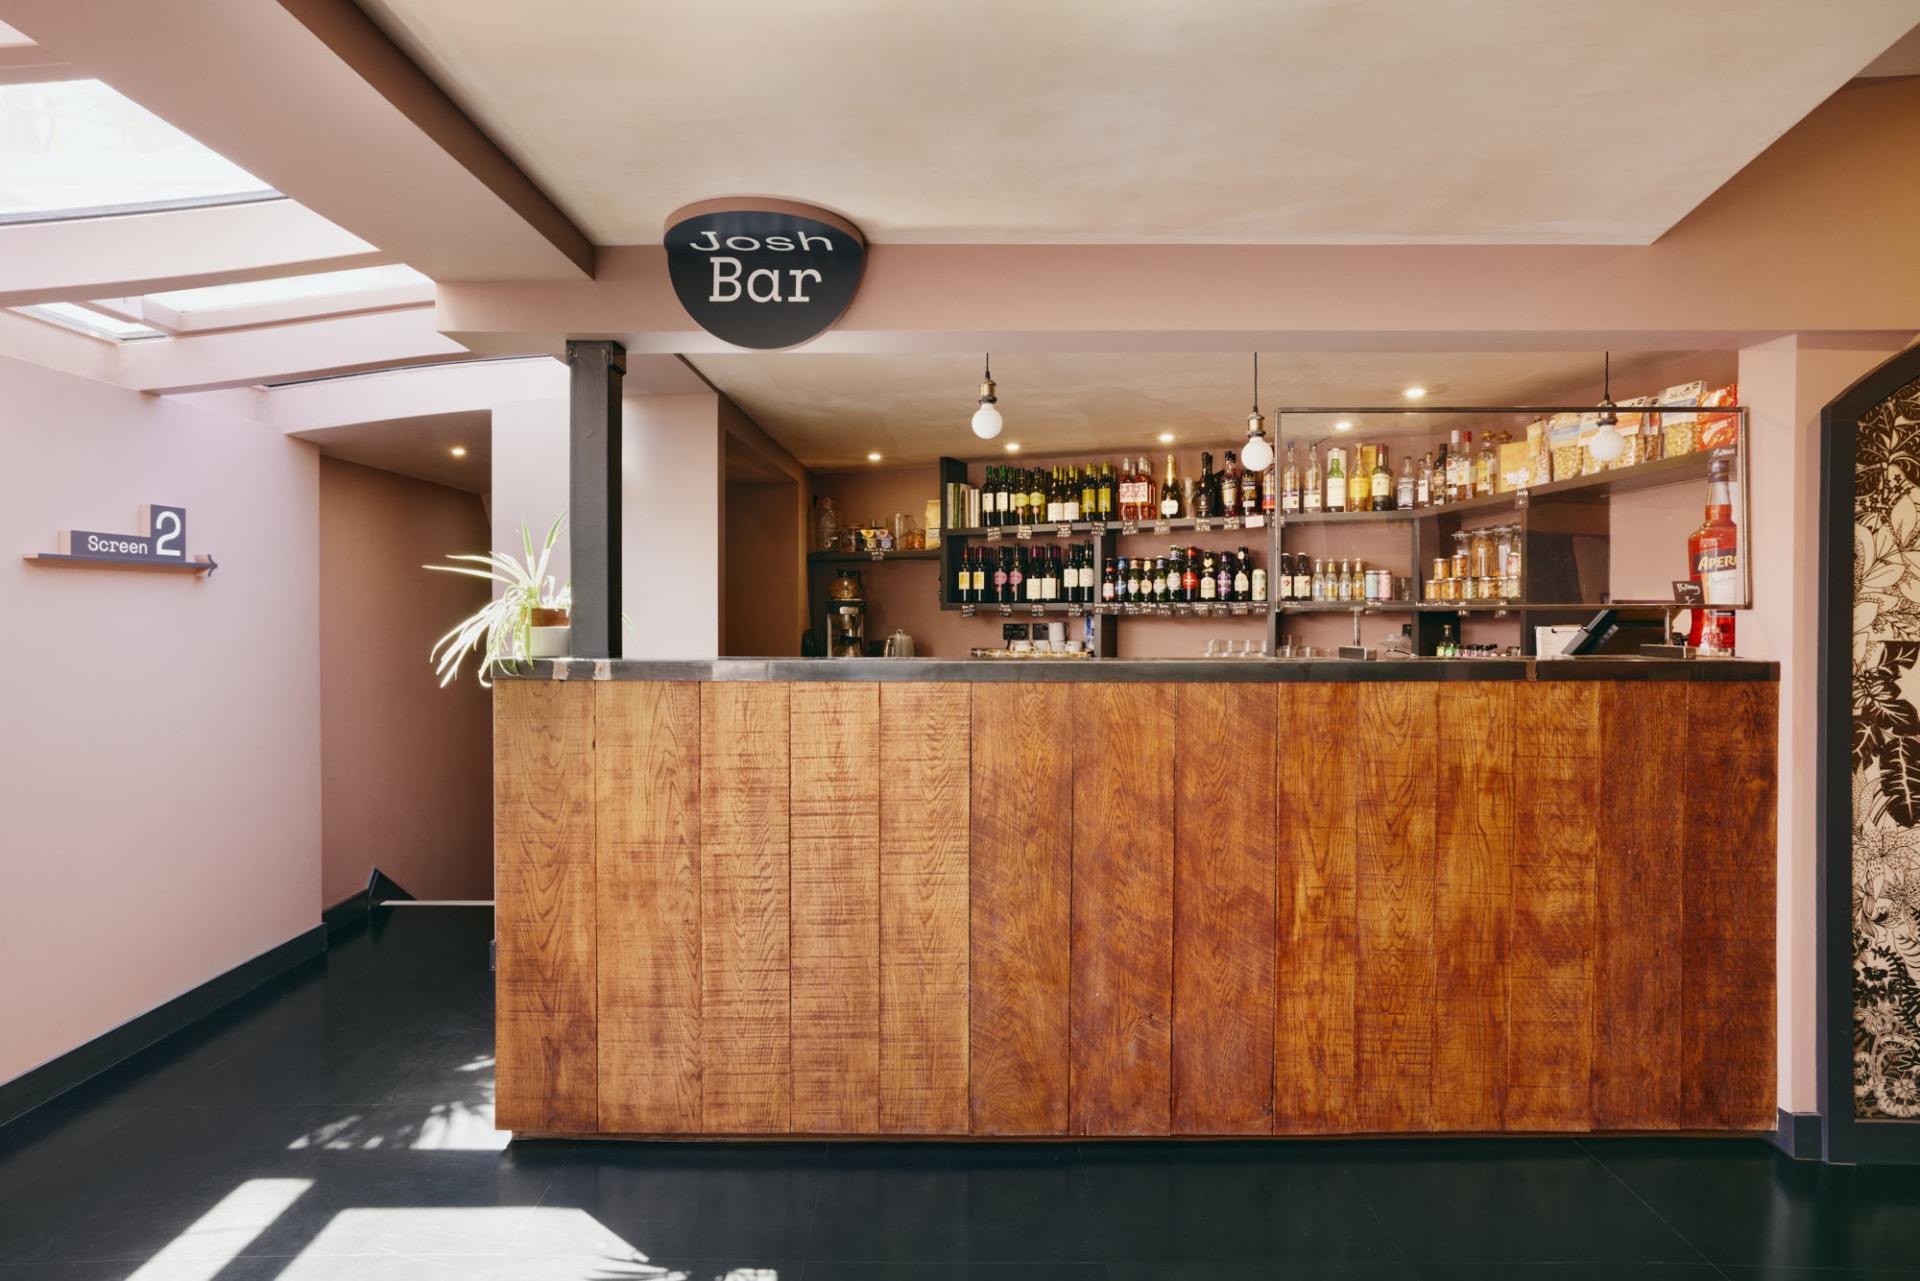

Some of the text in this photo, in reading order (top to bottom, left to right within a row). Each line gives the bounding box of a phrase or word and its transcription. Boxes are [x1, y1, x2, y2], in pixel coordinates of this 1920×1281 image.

[689, 231, 834, 252] Josh
[709, 256, 823, 304] Bar
[87, 510, 182, 557] Screen 2
